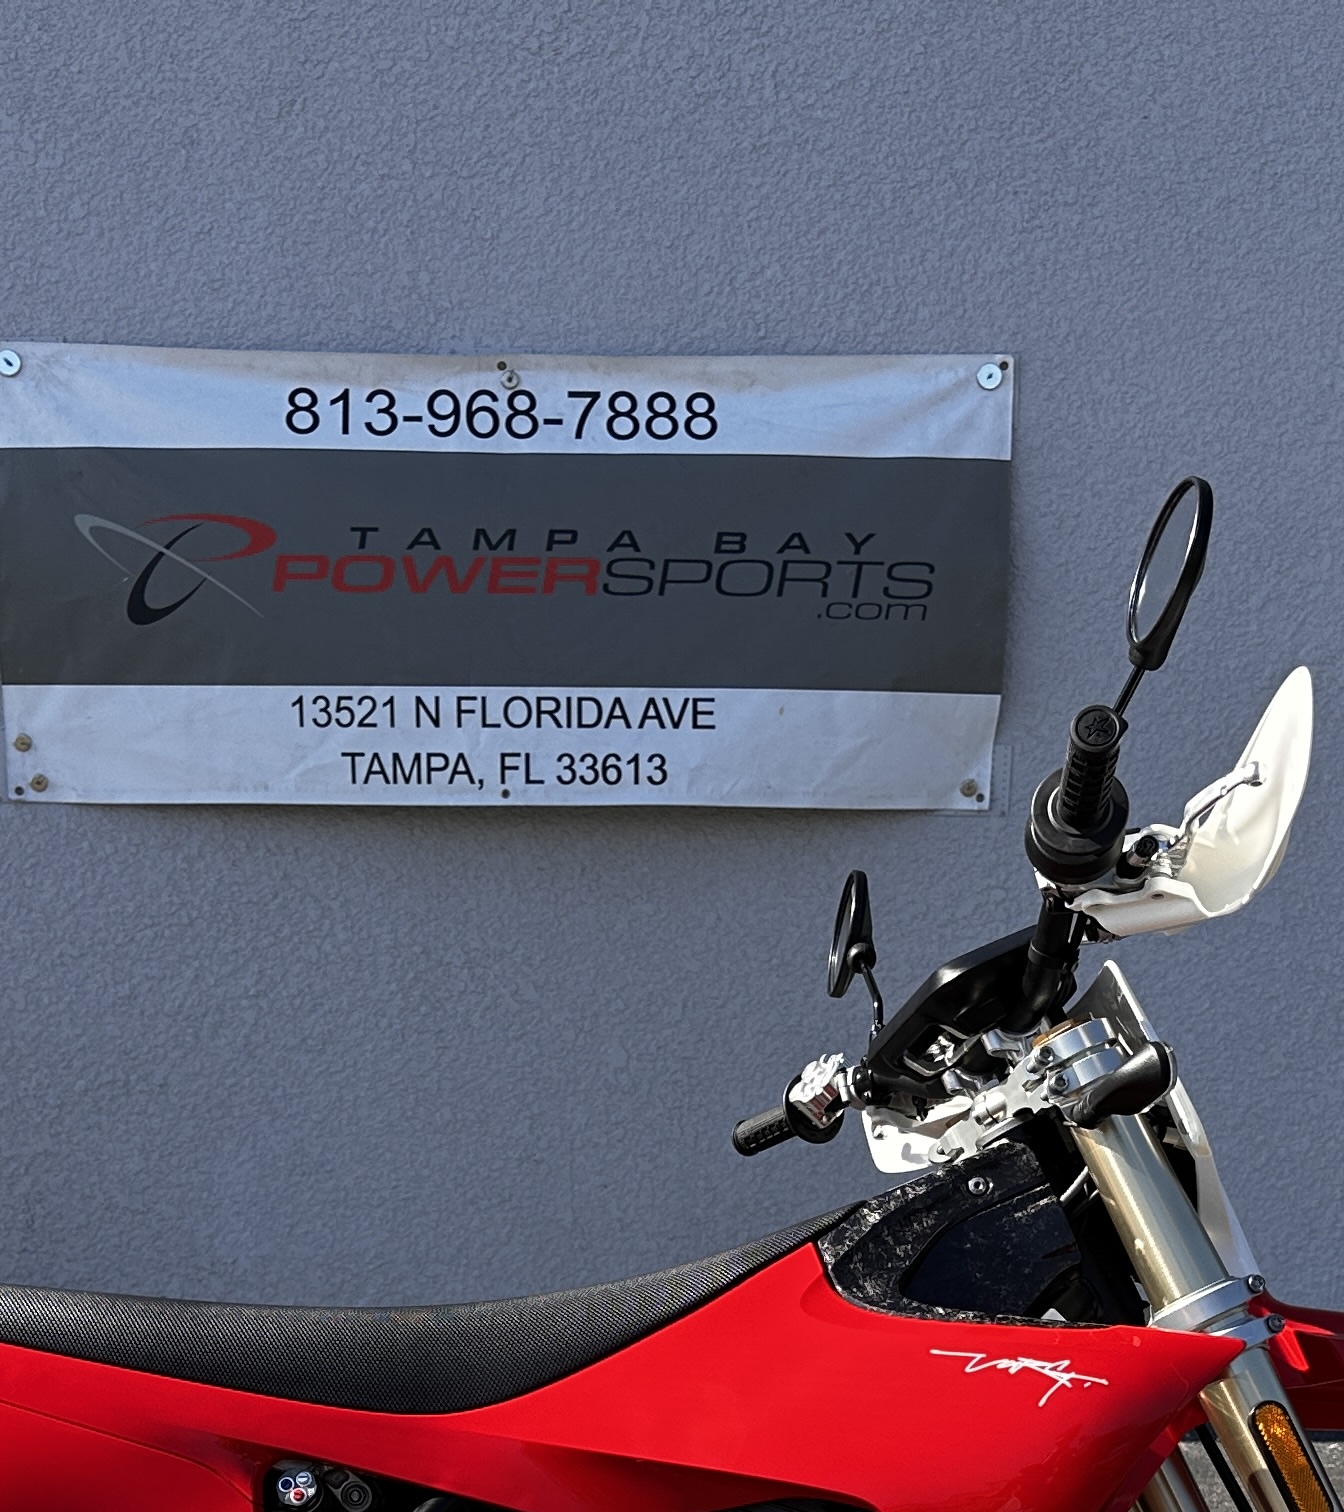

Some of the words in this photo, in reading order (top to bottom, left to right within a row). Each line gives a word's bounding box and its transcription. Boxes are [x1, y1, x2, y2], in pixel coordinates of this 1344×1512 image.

[285, 387, 719, 441] 813-968-7888
[348, 526, 643, 554] TAMPA
[712, 530, 878, 556] BAY
[272, 554, 937, 602] POWERSPORTS
[816, 601, 929, 622] .com
[291, 694, 396, 730] 13521
[415, 695, 442, 729] N
[456, 695, 633, 730] FLORIDA
[636, 696, 717, 731] AVE
[340, 751, 485, 791] TAMPA,
[499, 752, 545, 786] FL
[556, 752, 668, 787] 33613
